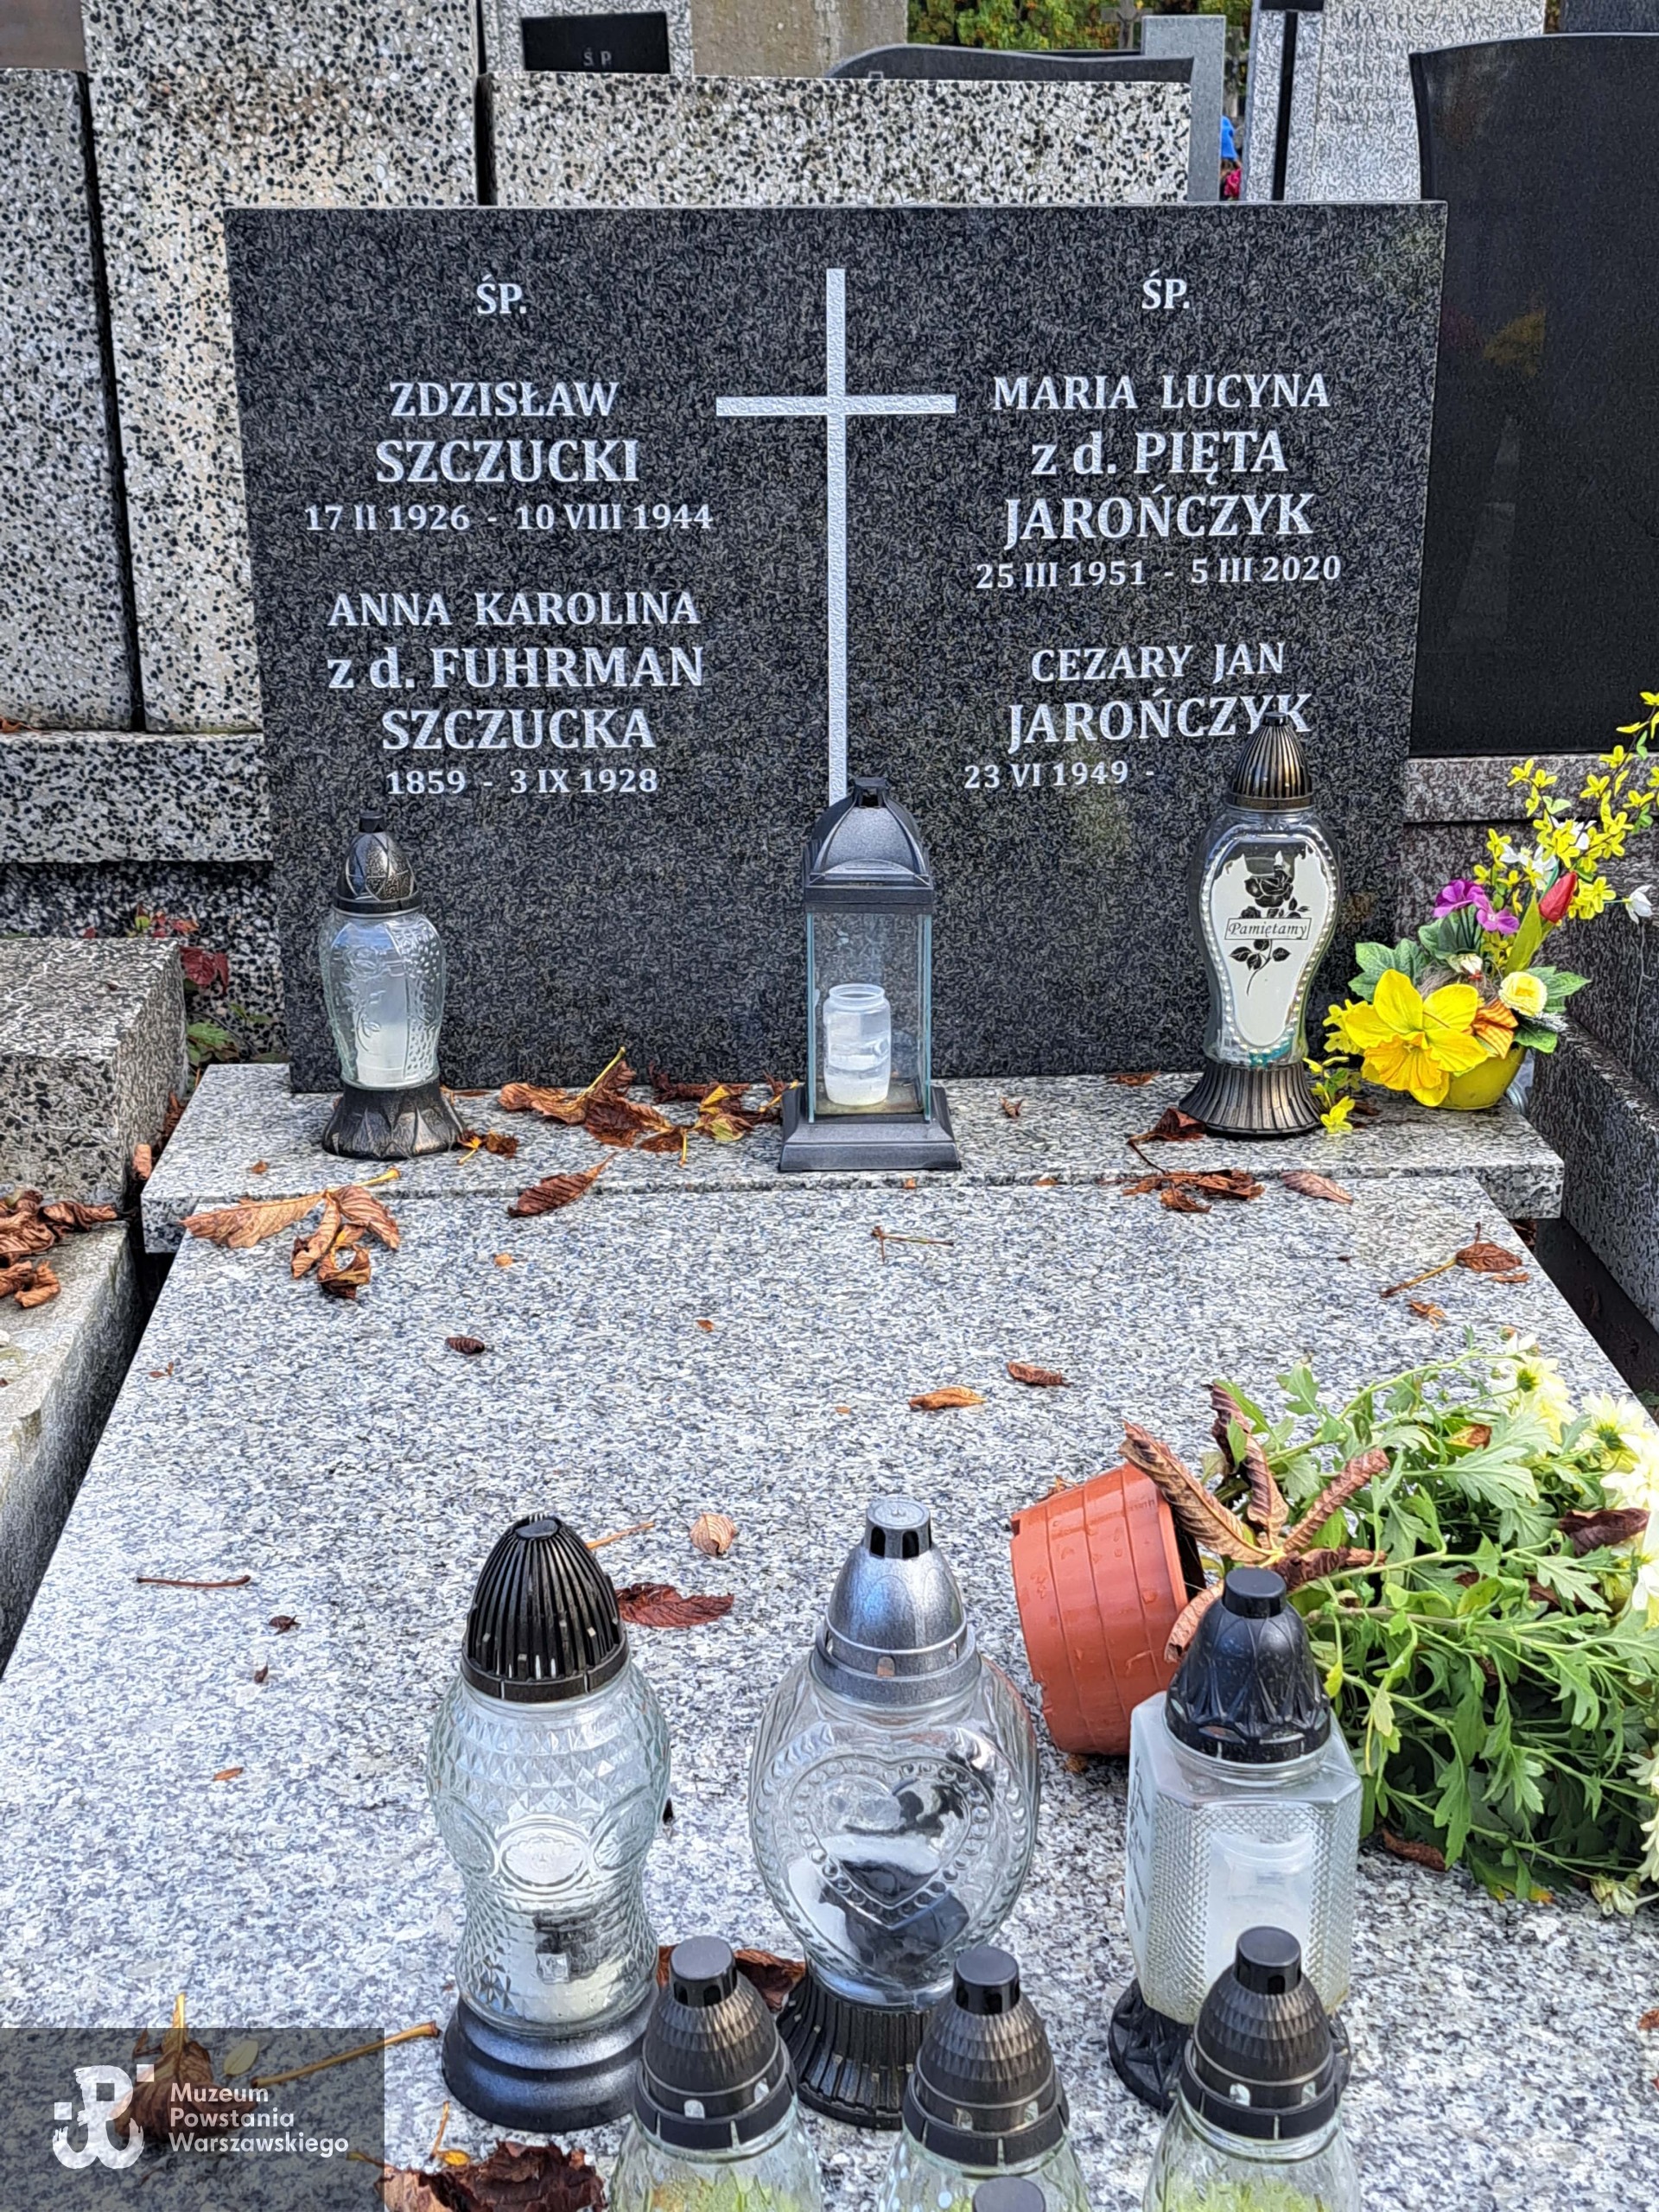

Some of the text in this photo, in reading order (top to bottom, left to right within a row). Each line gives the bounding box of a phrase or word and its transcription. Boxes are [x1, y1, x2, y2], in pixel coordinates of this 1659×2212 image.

[476, 273, 527, 315] ŚP.
[1141, 270, 1190, 310] ŚP.
[389, 381, 620, 416] ZDZISŁAW
[992, 372, 1331, 410] MARIA LUCYNA
[375, 439, 639, 483] SZCZUCKI
[1031, 429, 1288, 486] z d. PIĘTA
[304, 504, 343, 531] 17
[353, 504, 378, 531] II
[387, 503, 470, 531] 1926
[515, 503, 556, 531] 10
[563, 503, 622, 531] VIII
[632, 503, 714, 531] 1944
[1003, 484, 1315, 551] JAROŃCZYK
[975, 563, 1015, 589] 25
[1024, 562, 1058, 588] III
[1068, 559, 1146, 588] 1951
[1191, 557, 1209, 585] 5
[1218, 556, 1253, 584] III
[1262, 555, 1341, 583] 2020
[327, 591, 701, 626] ANNA KAROLINA
[327, 645, 703, 690] z d. FUHRMAN
[1031, 641, 1286, 683] CEZARY JAN
[382, 708, 657, 750] SZCZUCKA
[1007, 687, 1312, 754] JAROŃCZYK
[386, 768, 467, 795] 1859
[510, 768, 528, 794] 3
[537, 768, 570, 794] IX
[579, 767, 658, 794] 1928
[963, 764, 1001, 790] 23
[1010, 763, 1042, 788] VI
[1052, 760, 1129, 787] 1949
[1228, 921, 1307, 939] Pamiętamy
